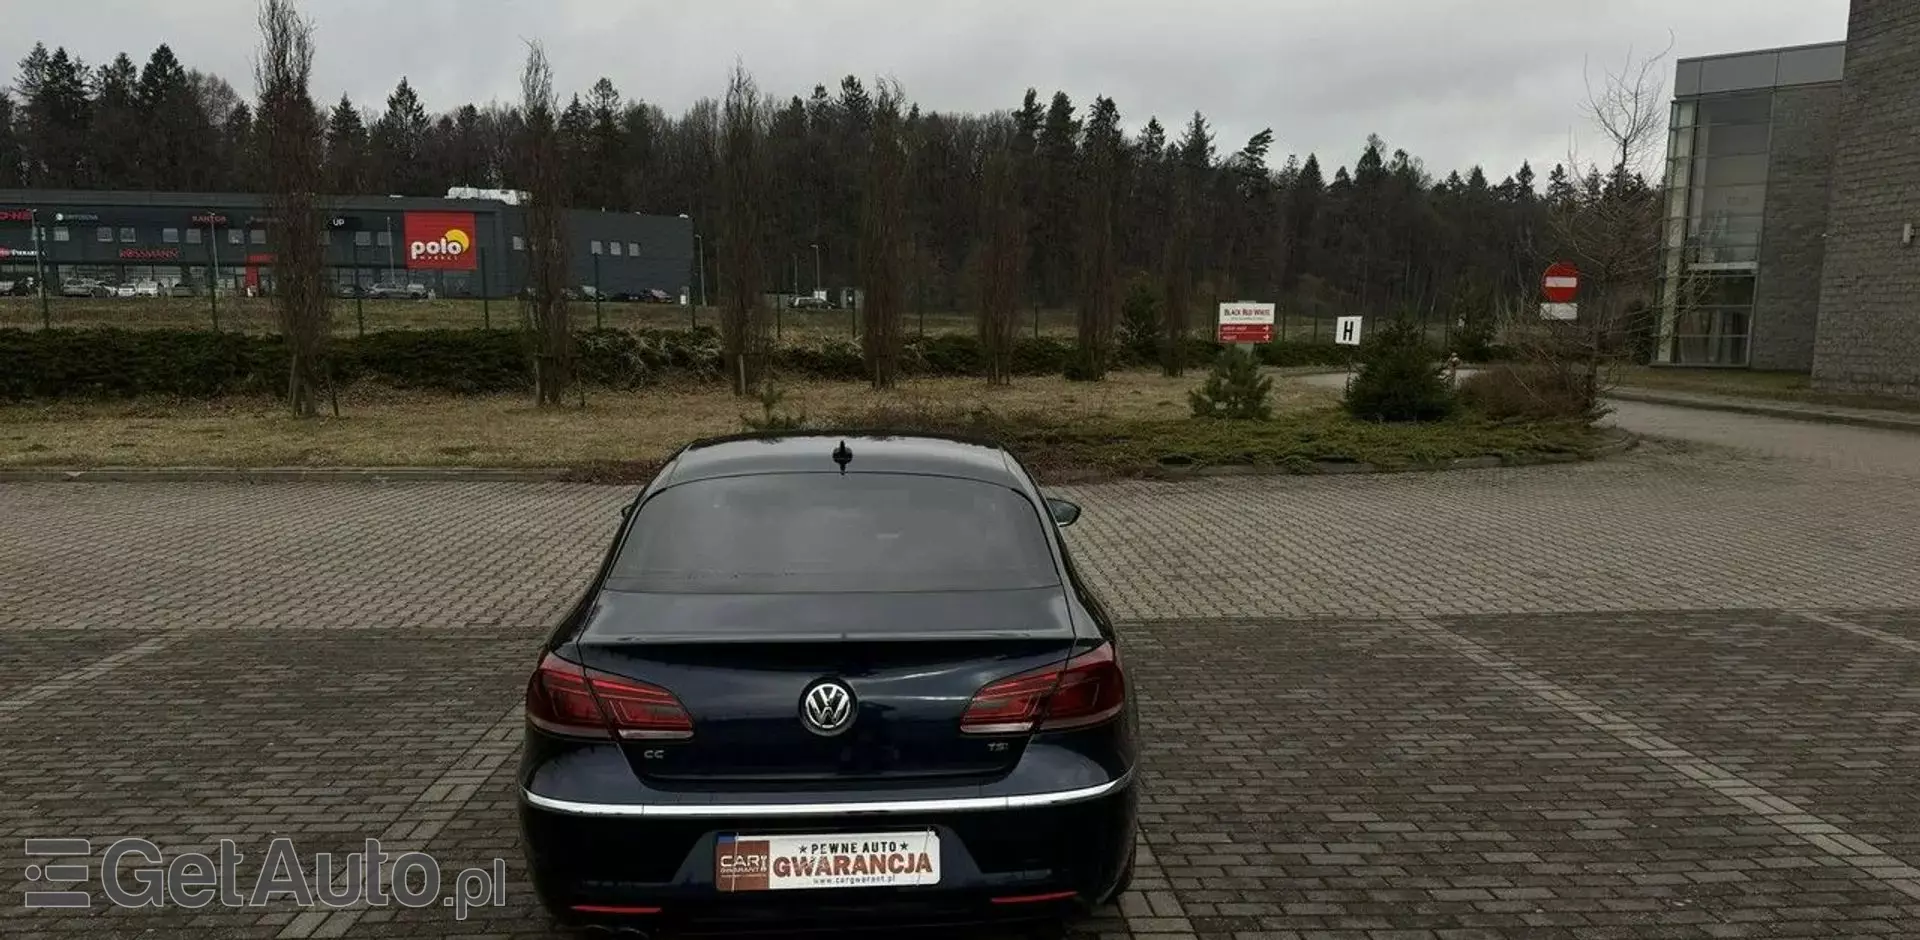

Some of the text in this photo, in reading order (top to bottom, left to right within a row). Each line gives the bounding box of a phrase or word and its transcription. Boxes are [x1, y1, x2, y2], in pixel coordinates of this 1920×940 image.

[411, 237, 462, 260] polo
[1224, 308, 1271, 317] BLACK RED WHITE
[1342, 320, 1354, 342] H
[643, 749, 665, 760] CC
[811, 841, 897, 855] PEWNE AUTO
[720, 854, 760, 868] CAR
[772, 852, 934, 878] GWARANCJA
[813, 874, 897, 885] www.cargwarant.pl
